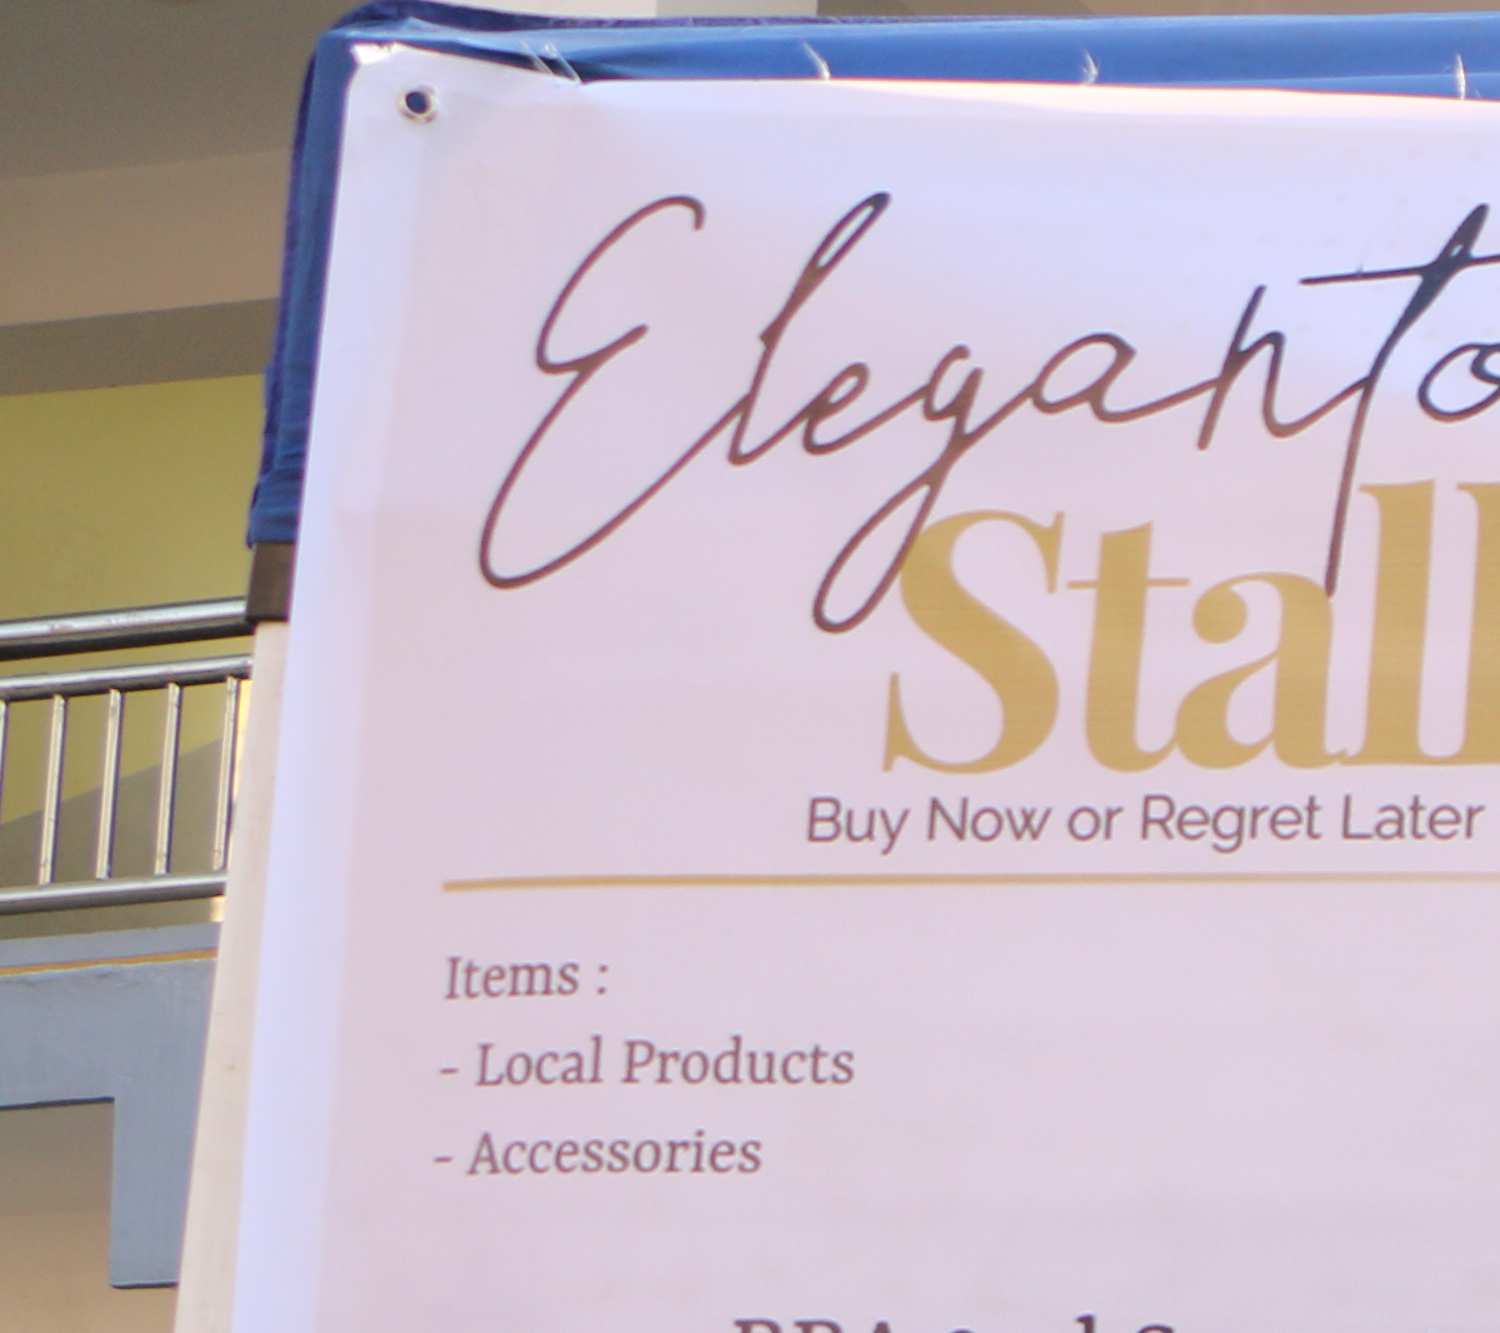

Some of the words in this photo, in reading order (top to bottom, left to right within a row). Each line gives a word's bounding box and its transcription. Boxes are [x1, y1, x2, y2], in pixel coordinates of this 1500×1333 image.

[806, 796, 910, 856] Buy
[927, 796, 1052, 843] Now
[1066, 806, 1124, 842] or
[1140, 794, 1322, 854] Regret
[1341, 794, 1486, 841] Later
[445, 956, 580, 1000] Items
[475, 1034, 603, 1087] Local
[621, 1034, 854, 1086] Products
[466, 1129, 762, 1176] Accessories
